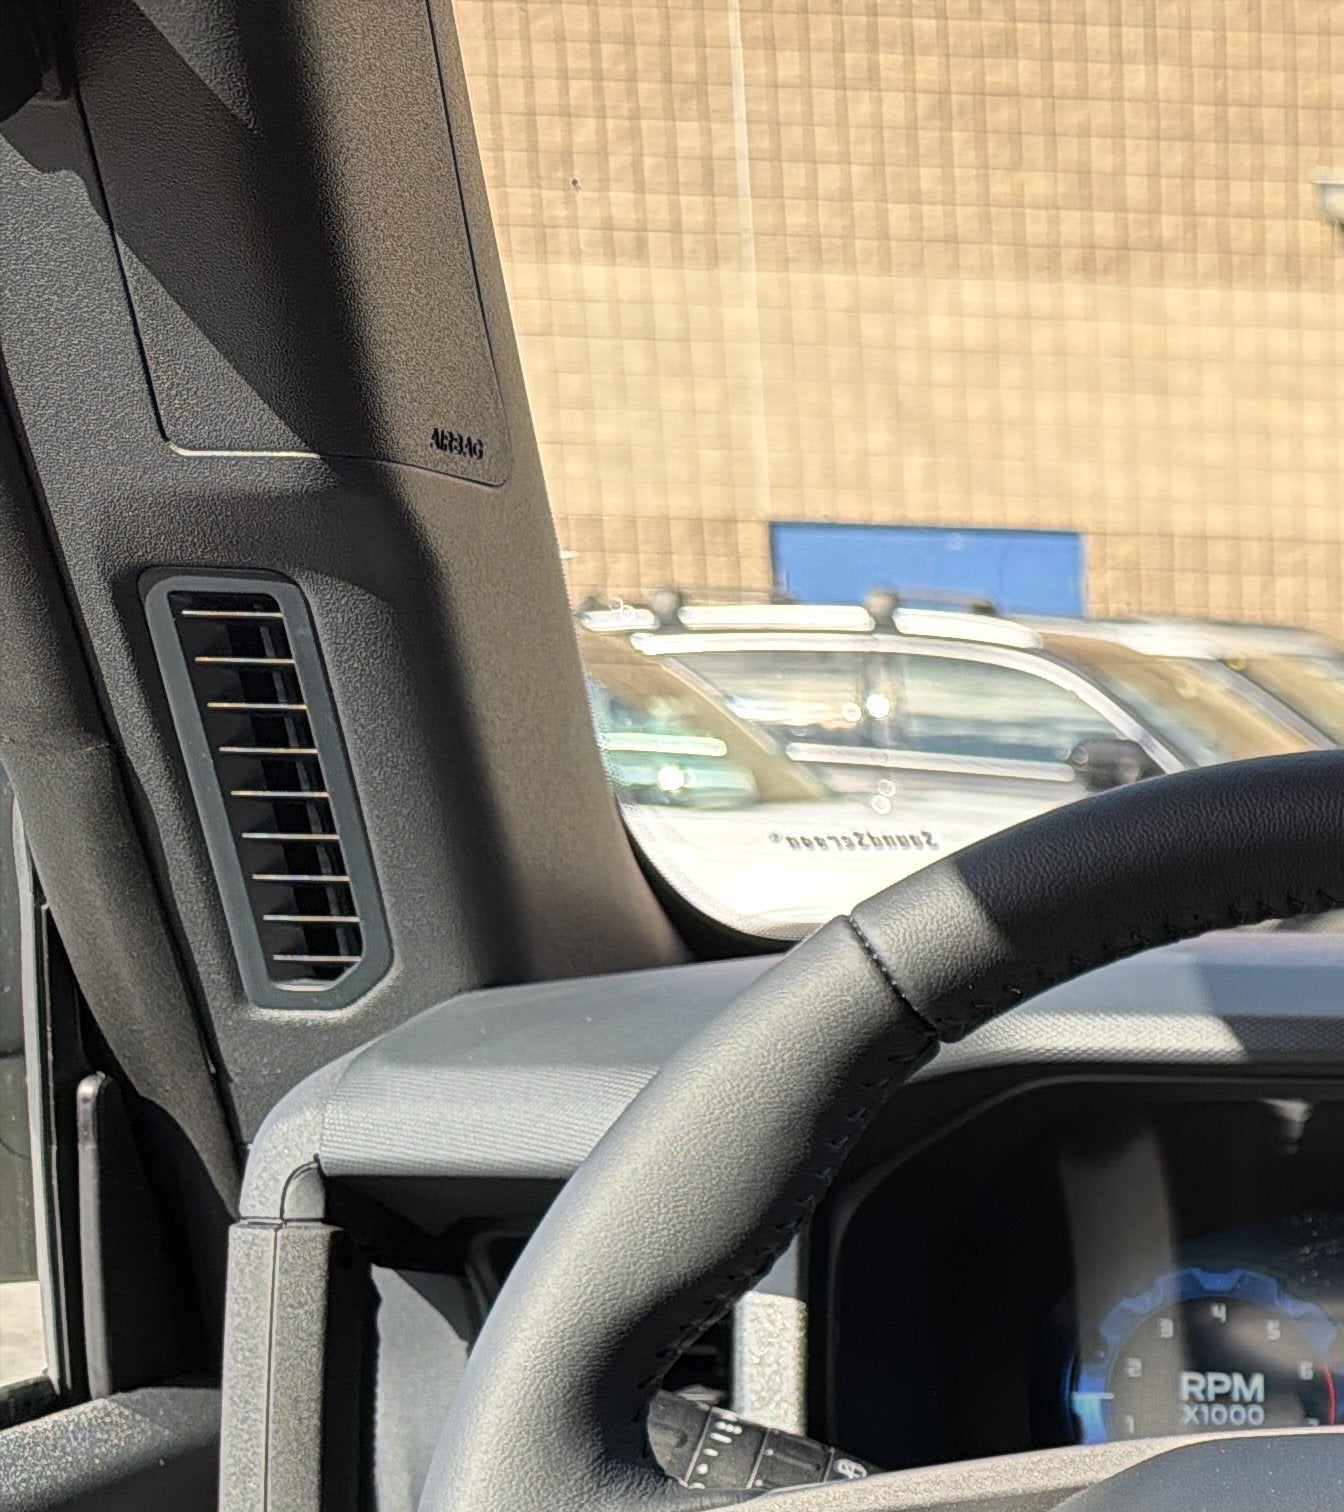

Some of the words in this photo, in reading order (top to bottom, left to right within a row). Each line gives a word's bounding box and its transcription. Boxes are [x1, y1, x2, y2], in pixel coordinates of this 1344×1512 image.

[1210, 1303, 1226, 1323] 4
[1160, 1318, 1174, 1339] 3
[1127, 1357, 1142, 1378] 2
[1180, 1371, 1265, 1402] RPM
[1181, 1404, 1265, 1426] X1000
